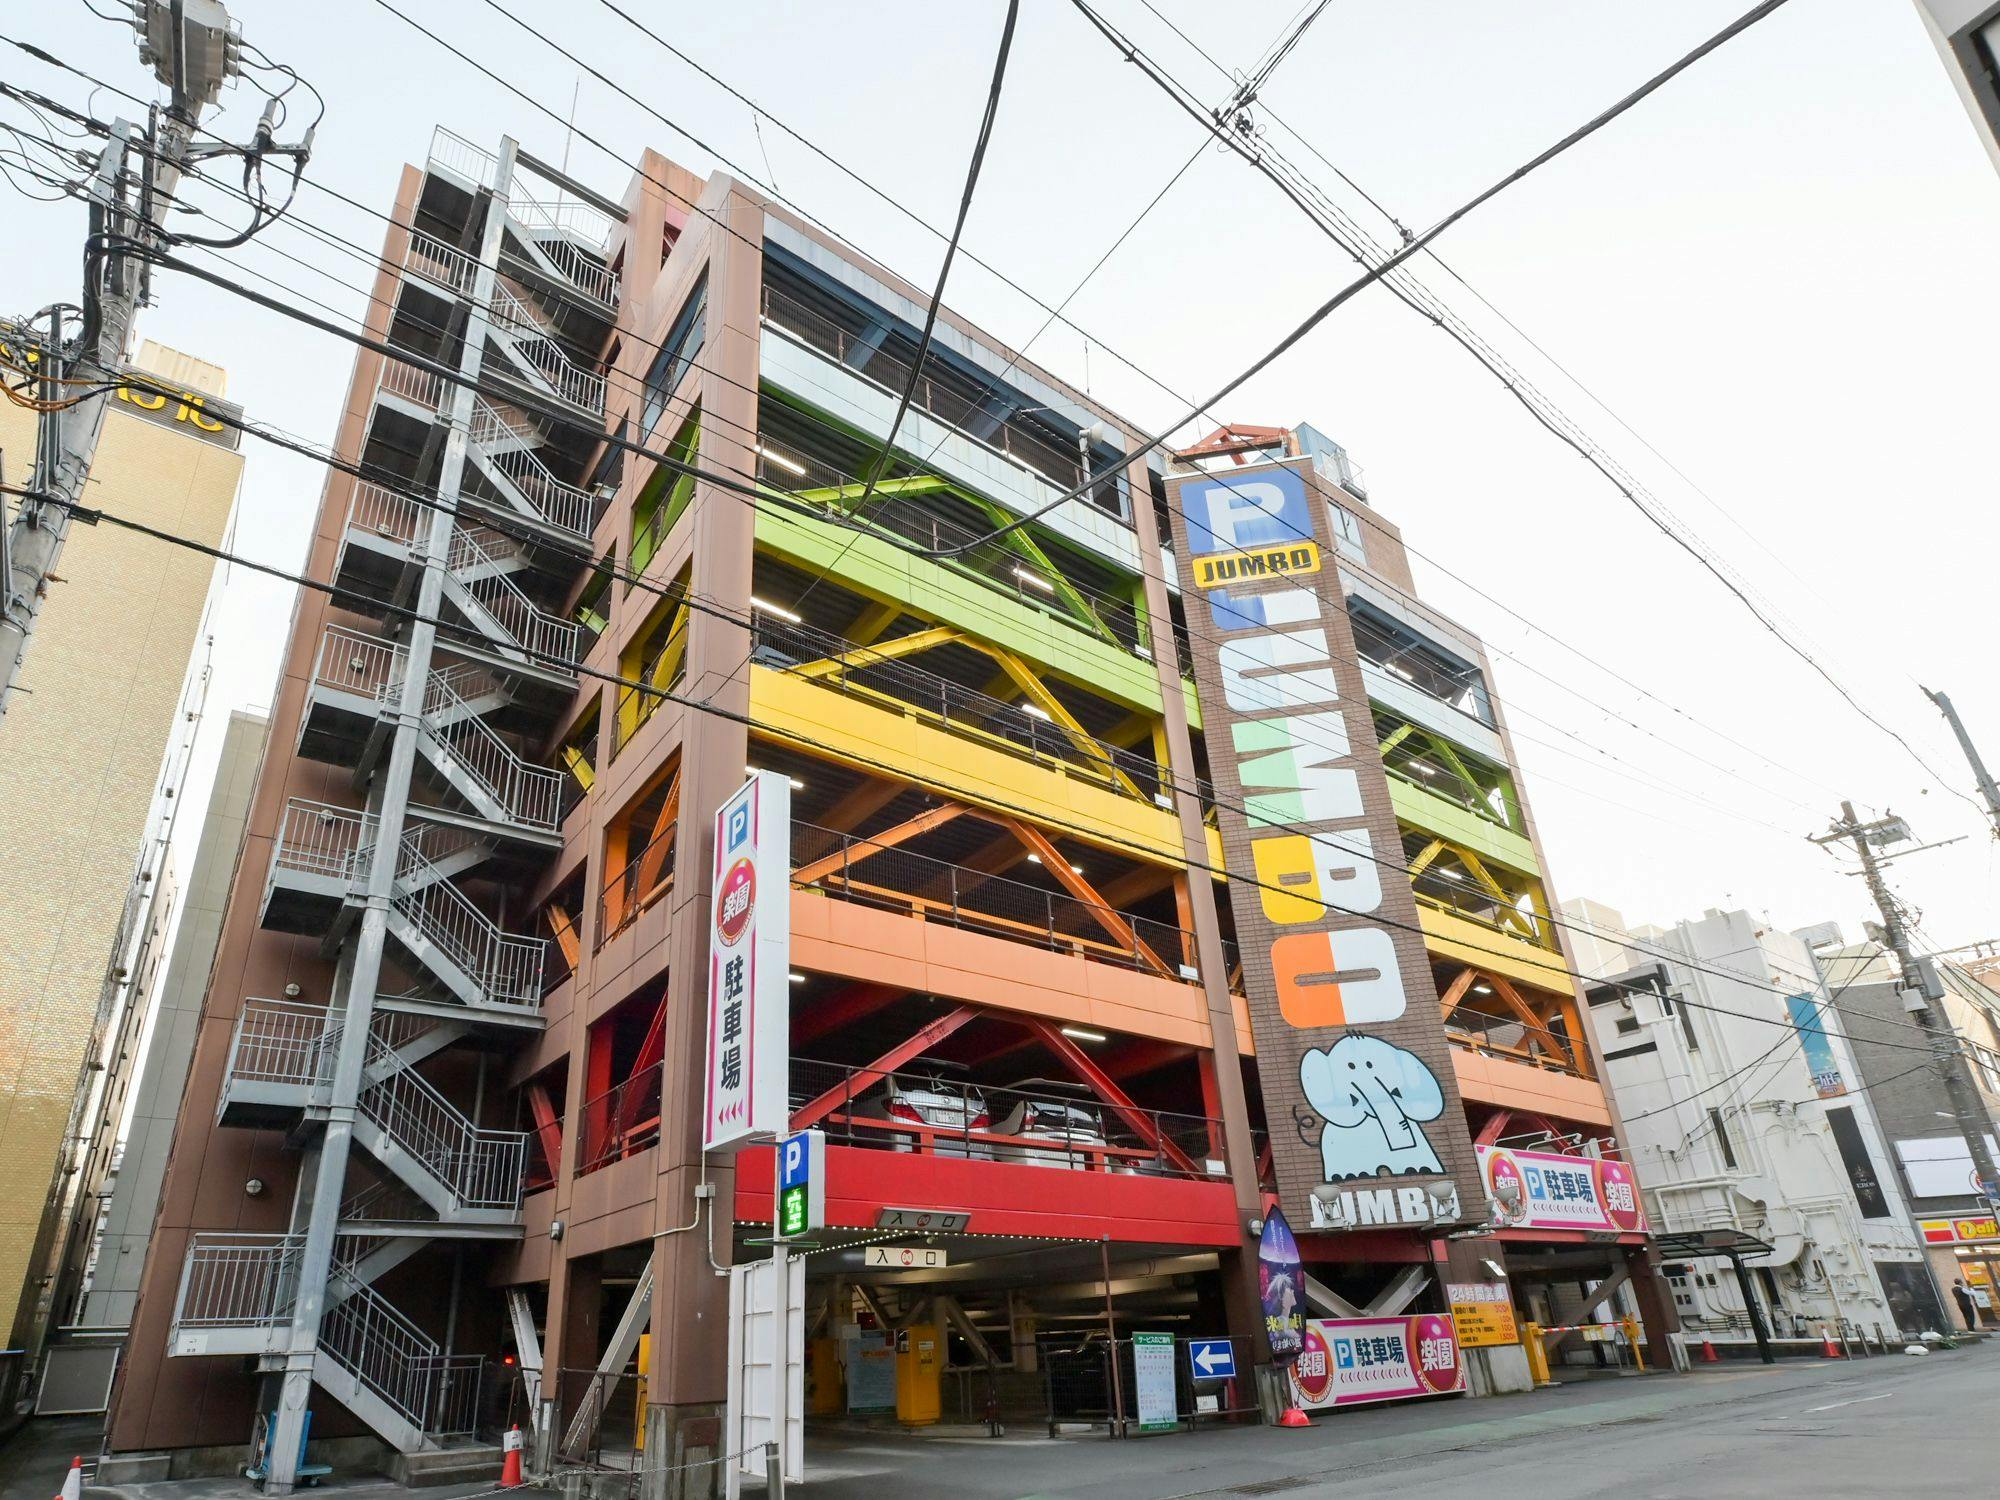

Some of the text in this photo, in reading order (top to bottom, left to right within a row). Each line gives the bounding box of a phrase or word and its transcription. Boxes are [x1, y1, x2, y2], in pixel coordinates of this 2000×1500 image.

[1205, 482, 1285, 551] P
[1203, 548, 1312, 582] JUMBO
[1208, 586, 1407, 1029] JUMBO
[731, 810, 746, 848] P
[722, 880, 751, 925] 楽園
[720, 954, 744, 1091] 駐車場
[786, 1140, 801, 1185] P
[1528, 1169, 1594, 1203] P 駐車場
[1605, 1181, 1635, 1211] 楽園
[786, 1188, 802, 1230] 空
[1297, 1351, 1326, 1378] 楽園
[1337, 1336, 1405, 1367] P 駐車場
[1420, 1337, 1455, 1372] 楽園
